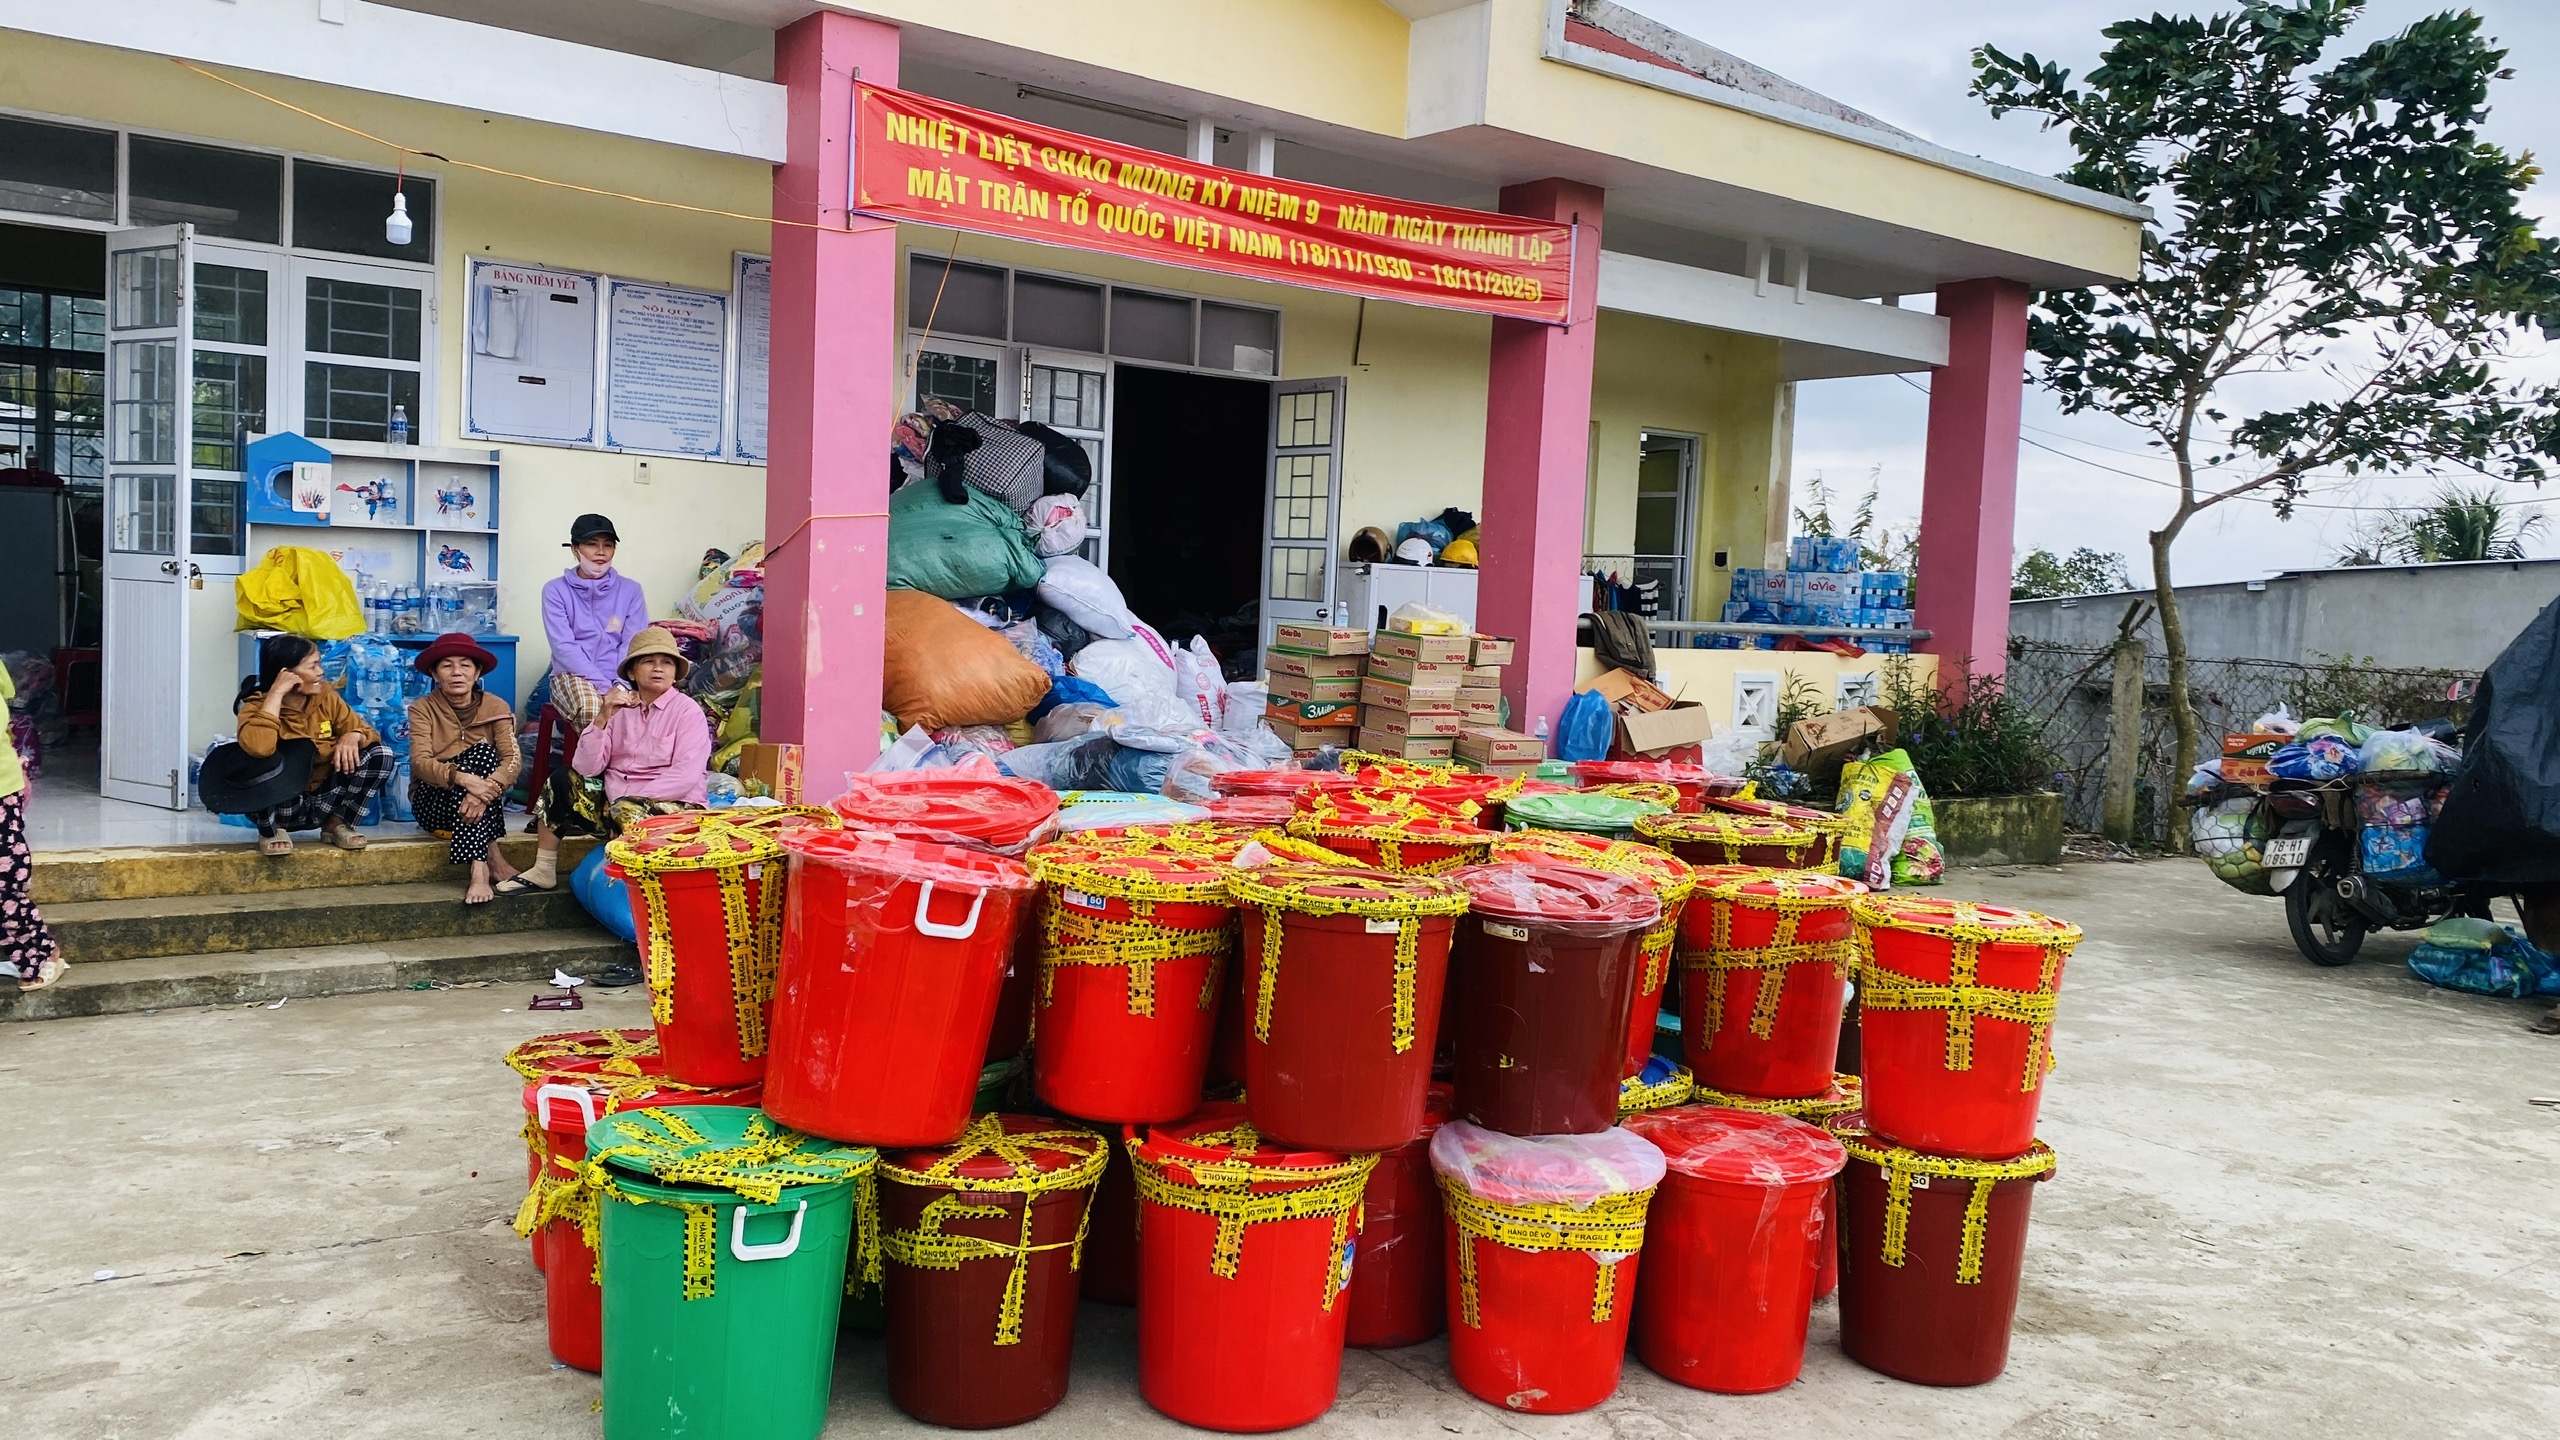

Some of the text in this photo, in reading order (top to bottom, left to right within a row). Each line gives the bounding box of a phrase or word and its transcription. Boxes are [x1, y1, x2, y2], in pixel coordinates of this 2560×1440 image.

[886, 111, 1553, 267] NHIỆT LIỆT CHÀO MỪNG KỶ NIỆM 9 NĂM NGÀY THÀNH LẬP
[907, 167, 970, 208] MẶT
[977, 180, 1049, 222] TRẬN
[1057, 188, 1092, 226] TỔ
[1097, 200, 1165, 239] QUỐC
[1173, 209, 1223, 253] VIỆT
[1229, 227, 1282, 260] NAM
[1289, 239, 1413, 281] (18/11/1930
[1432, 263, 1543, 304] 18/11/2025)
[494, 269, 523, 283] BẢNG
[557, 276, 577, 290] YẾT
[667, 308, 693, 316] QUY
[1767, 579, 1786, 588] laVi
[1808, 581, 1836, 592] laVie
[1090, 896, 1102, 905] 50
[1512, 928, 1525, 938] 50
[765, 930, 773, 963] FRAGILE
[1128, 943, 1163, 953] FRAGILE
[660, 946, 668, 981] FRAGILE
[737, 954, 747, 988] FRAGILE
[1762, 977, 1774, 1006] FRAGILE
[1046, 1171, 1076, 1183] FRAGILE
[1202, 1173, 1238, 1182] FRAGILE
[1913, 1177, 1926, 1185] 50
[1300, 1198, 1328, 1209] FRAGILE
[1460, 1211, 1486, 1229] FRAGILE
[698, 1221, 706, 1243] HÀNG
[1508, 1229, 1528, 1237] HÀNG
